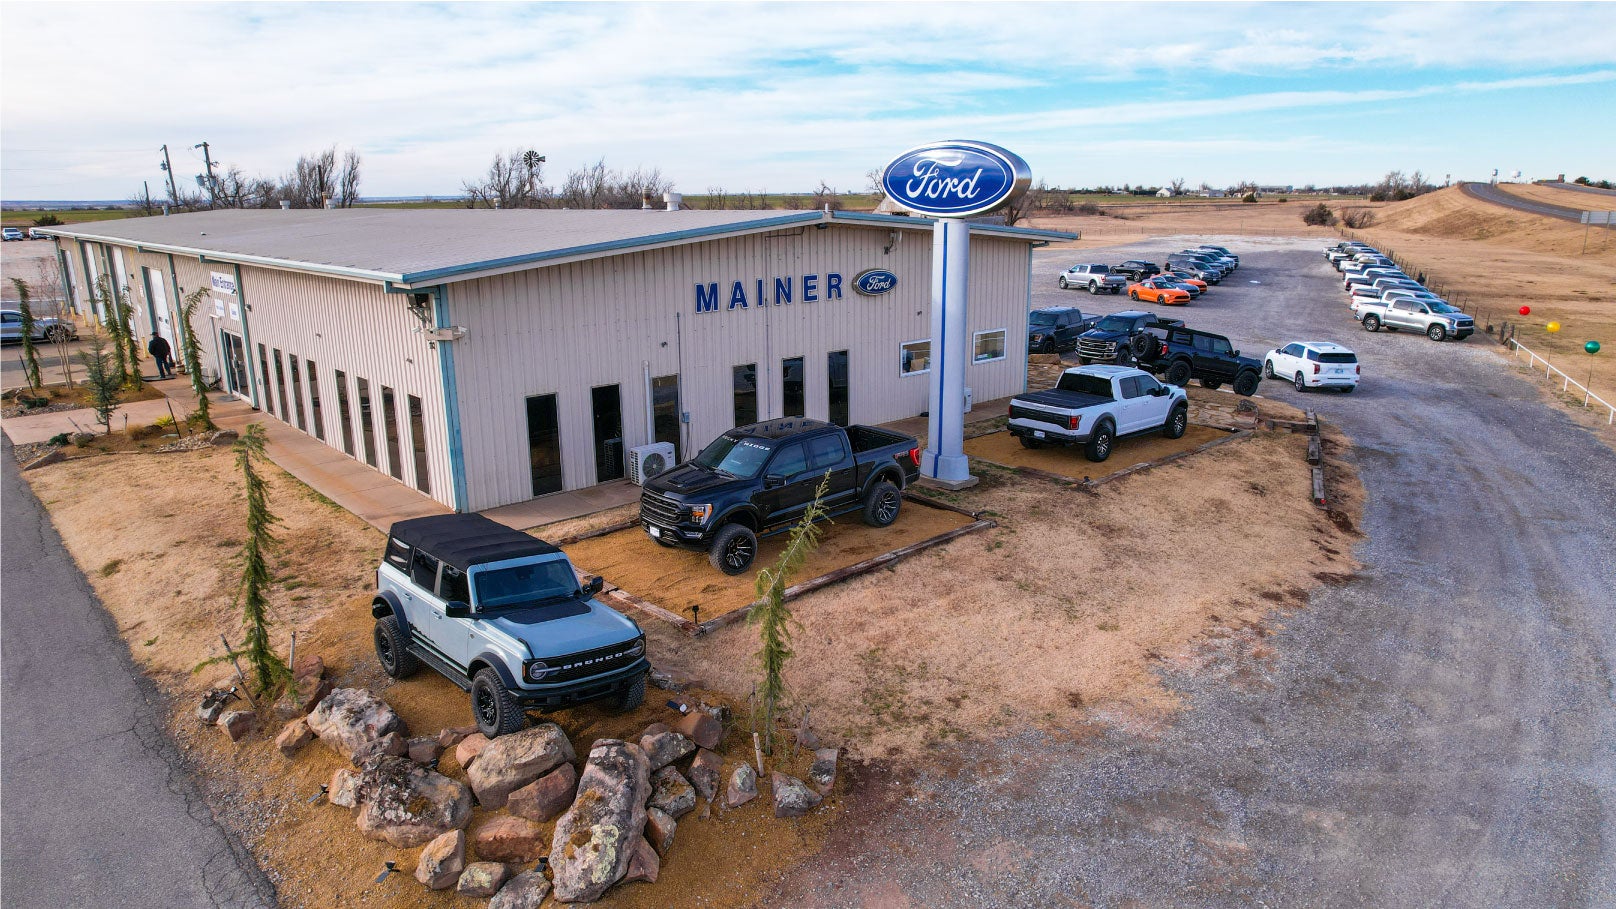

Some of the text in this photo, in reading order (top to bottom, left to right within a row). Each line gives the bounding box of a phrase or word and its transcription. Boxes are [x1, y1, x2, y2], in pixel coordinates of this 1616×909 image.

[906, 155, 983, 199] Ford
[695, 273, 843, 313] MAINER
[866, 275, 892, 290] Ford
[563, 652, 623, 669] BRONCO
